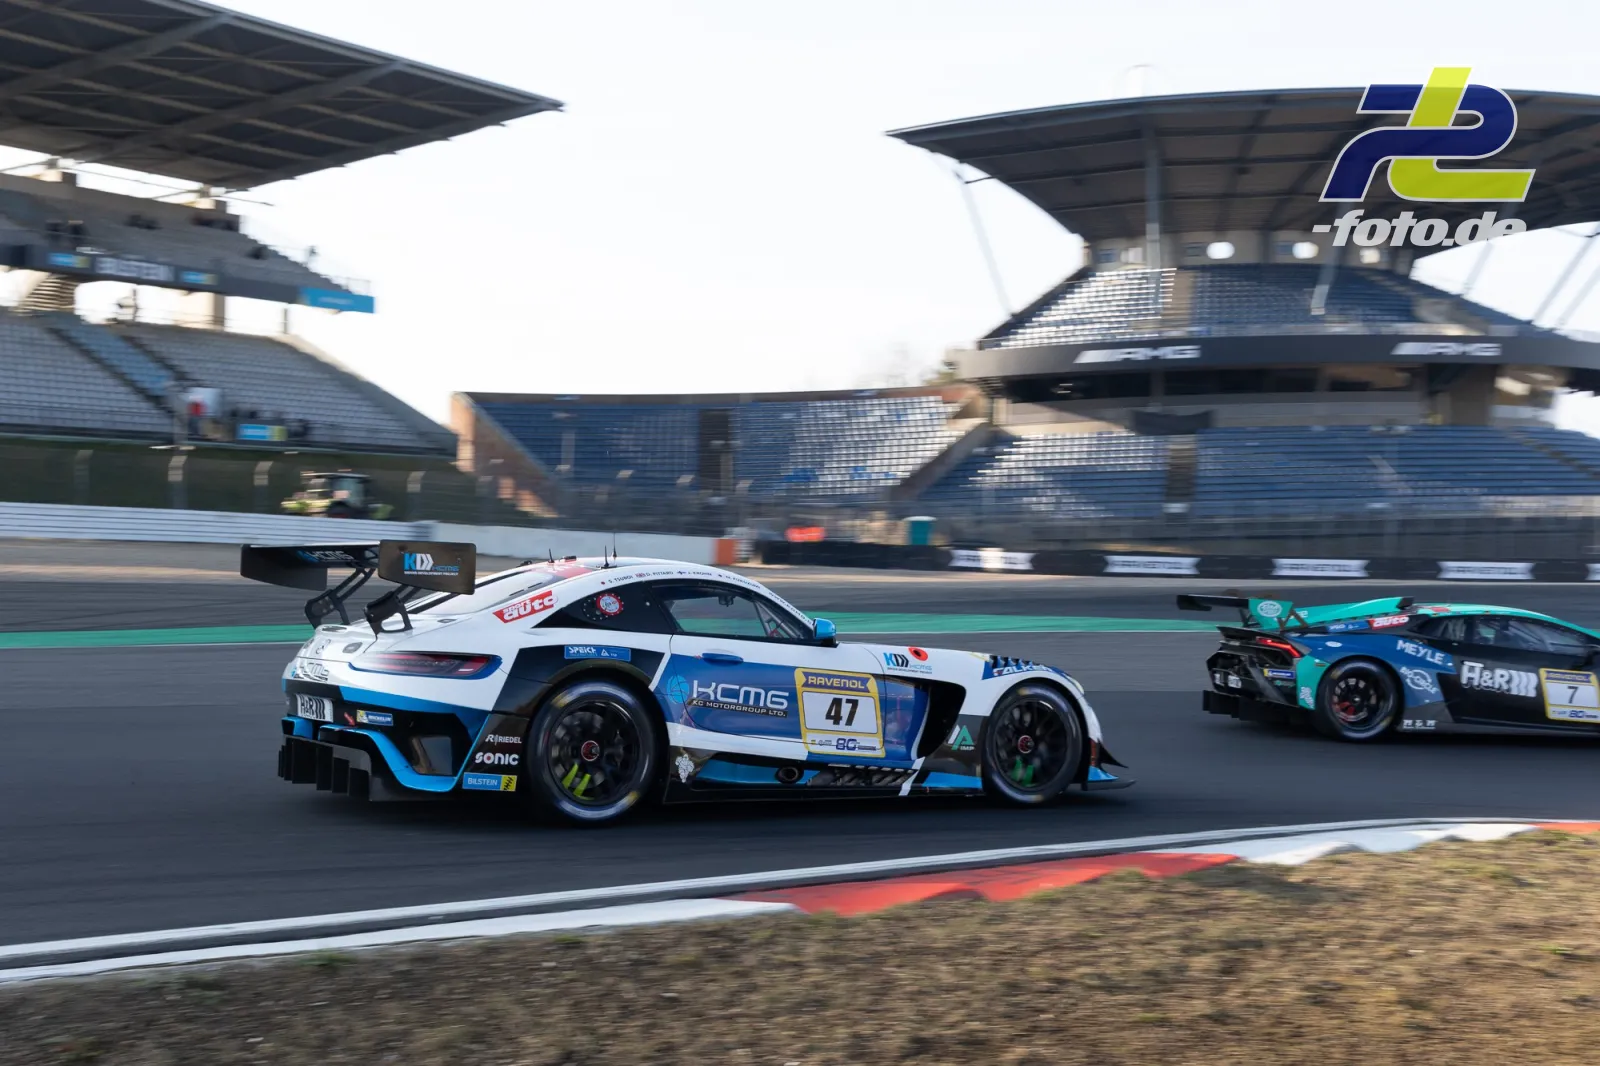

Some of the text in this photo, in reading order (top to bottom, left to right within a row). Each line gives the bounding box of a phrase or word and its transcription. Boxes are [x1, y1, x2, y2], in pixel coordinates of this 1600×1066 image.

[503, 594, 558, 620] auto
[1396, 640, 1445, 665] MEYLE
[808, 675, 866, 690] RAVENOL
[693, 680, 790, 710] KCMG
[1567, 685, 1579, 704] 7
[691, 699, 786, 717] KC MOTORGROUP LTD.
[825, 697, 859, 727] 47
[498, 736, 522, 744] RIEDEL
[467, 778, 498, 786] BILSTEIN
